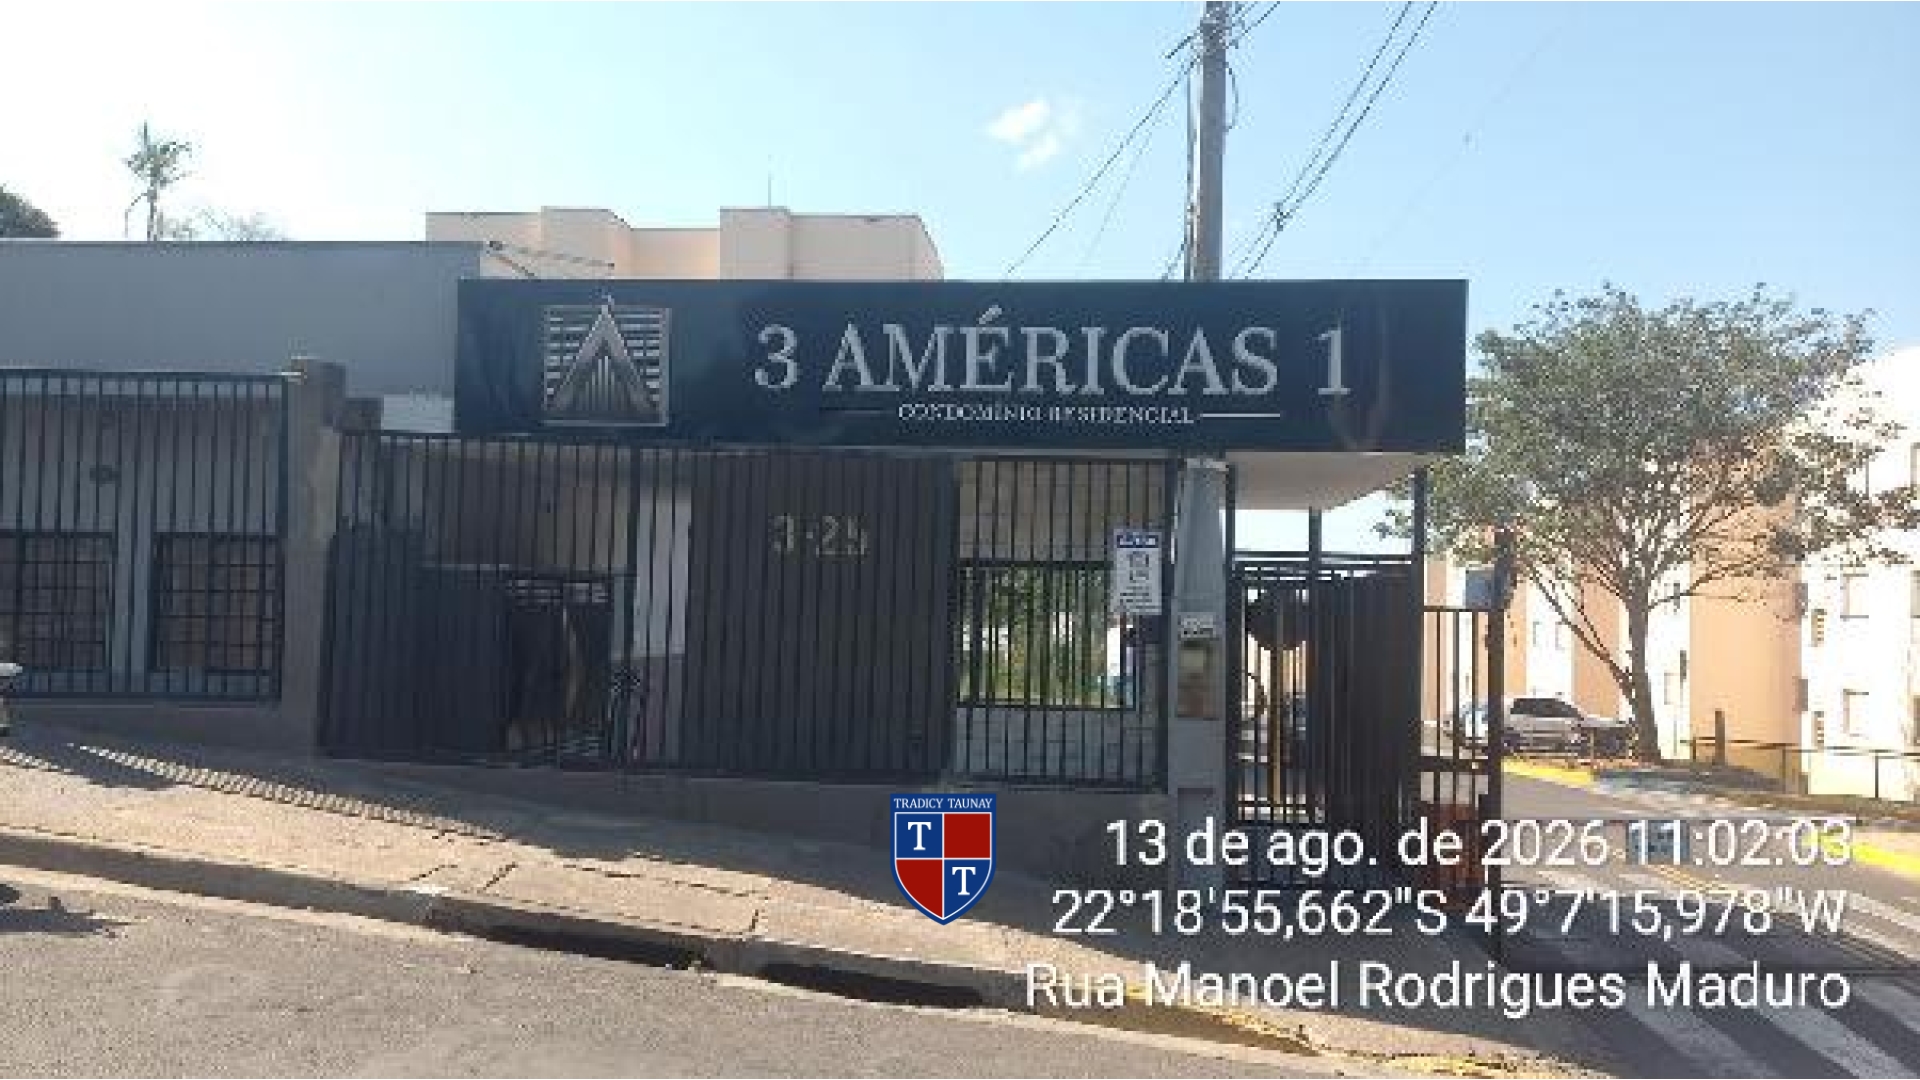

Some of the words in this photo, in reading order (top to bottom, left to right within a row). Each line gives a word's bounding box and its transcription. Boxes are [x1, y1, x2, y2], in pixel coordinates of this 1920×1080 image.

[754, 323, 799, 389] 3
[822, 305, 1280, 395] AMÉRICAS
[1316, 326, 1352, 395] 1
